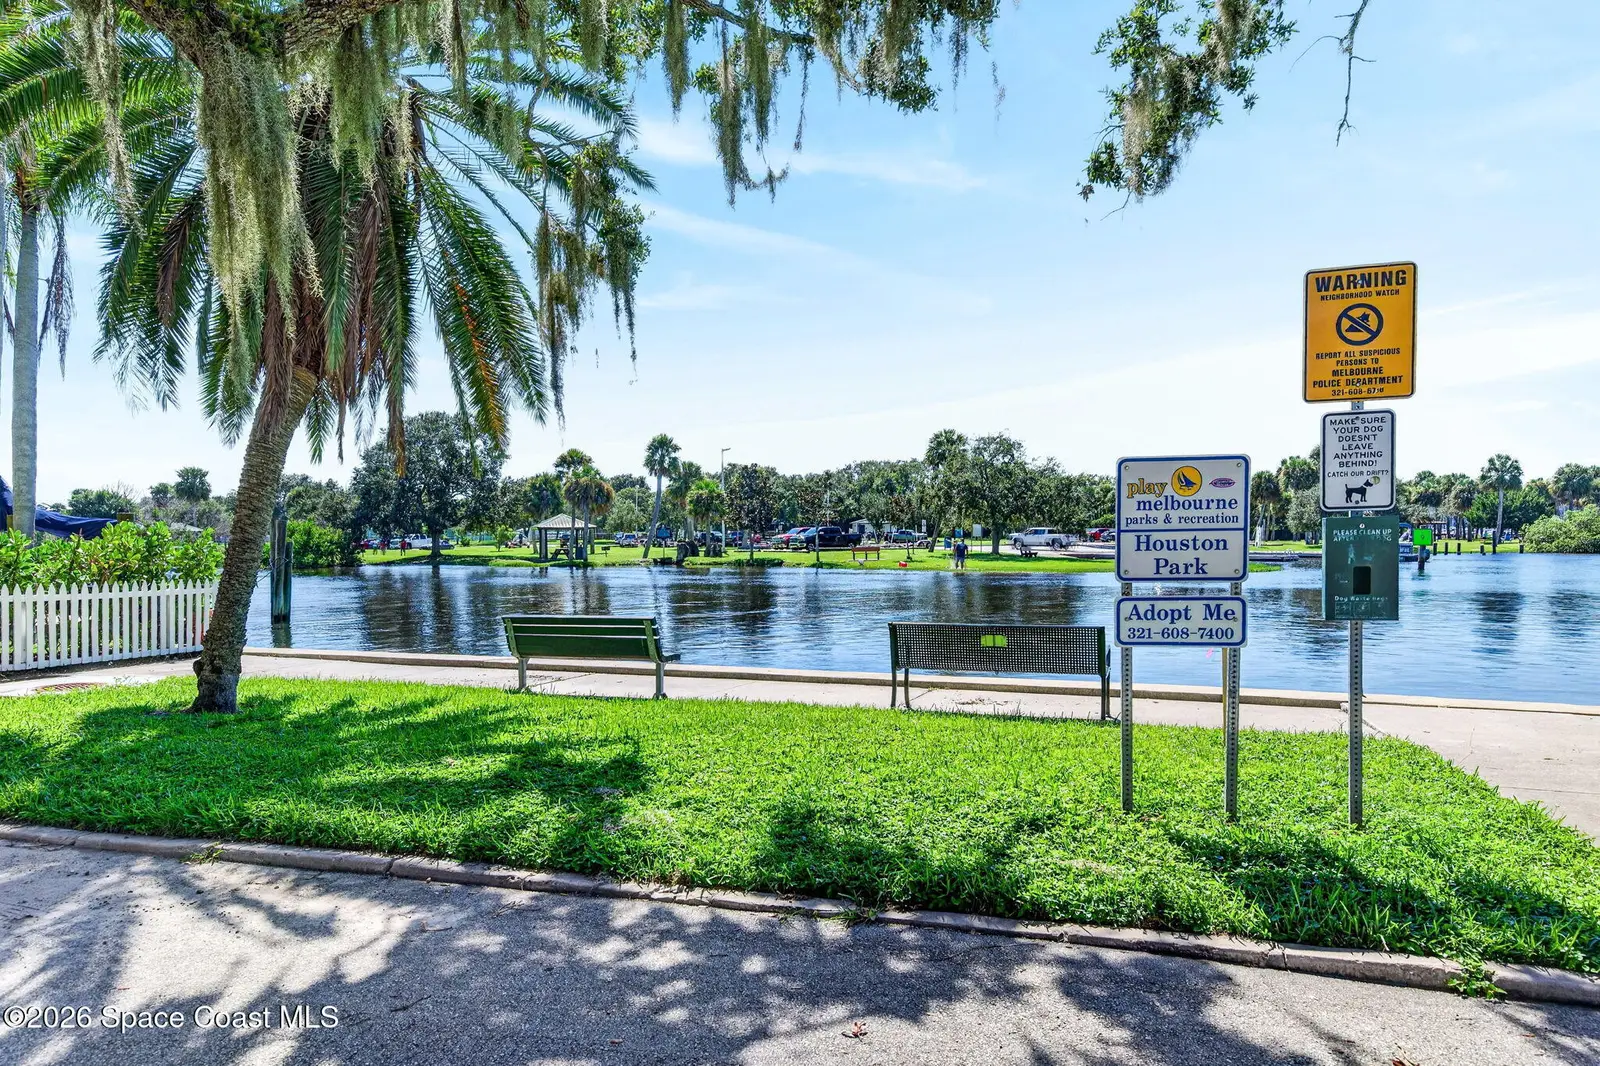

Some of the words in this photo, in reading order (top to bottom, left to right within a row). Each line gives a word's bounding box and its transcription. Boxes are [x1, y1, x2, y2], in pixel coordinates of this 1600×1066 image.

[1316, 270, 1407, 292] WARNING
[1320, 291, 1372, 301] NEIGHBORHOOD
[1359, 348, 1400, 357] SUSPICIOUS
[1332, 367, 1383, 377] MELBOURNE
[1313, 378, 1341, 388] POLICE
[1346, 375, 1404, 387] DEPARTMENT
[1338, 434, 1378, 442] DOESN'T
[1342, 443, 1374, 451] LEAVE
[1333, 451, 1383, 460] ANYTHING
[1339, 460, 1377, 468] BEHIND!
[1127, 478, 1168, 498] play
[1136, 495, 1239, 511] melbourne
[1125, 514, 1158, 527] parks
[1164, 513, 1172, 524] &
[1178, 512, 1239, 524] recreation
[1134, 534, 1228, 552] Houston
[1154, 557, 1208, 575] Park
[1128, 604, 1192, 624] Adopt
[1203, 603, 1236, 621] Me
[1128, 627, 1234, 640] 321-608-7400
